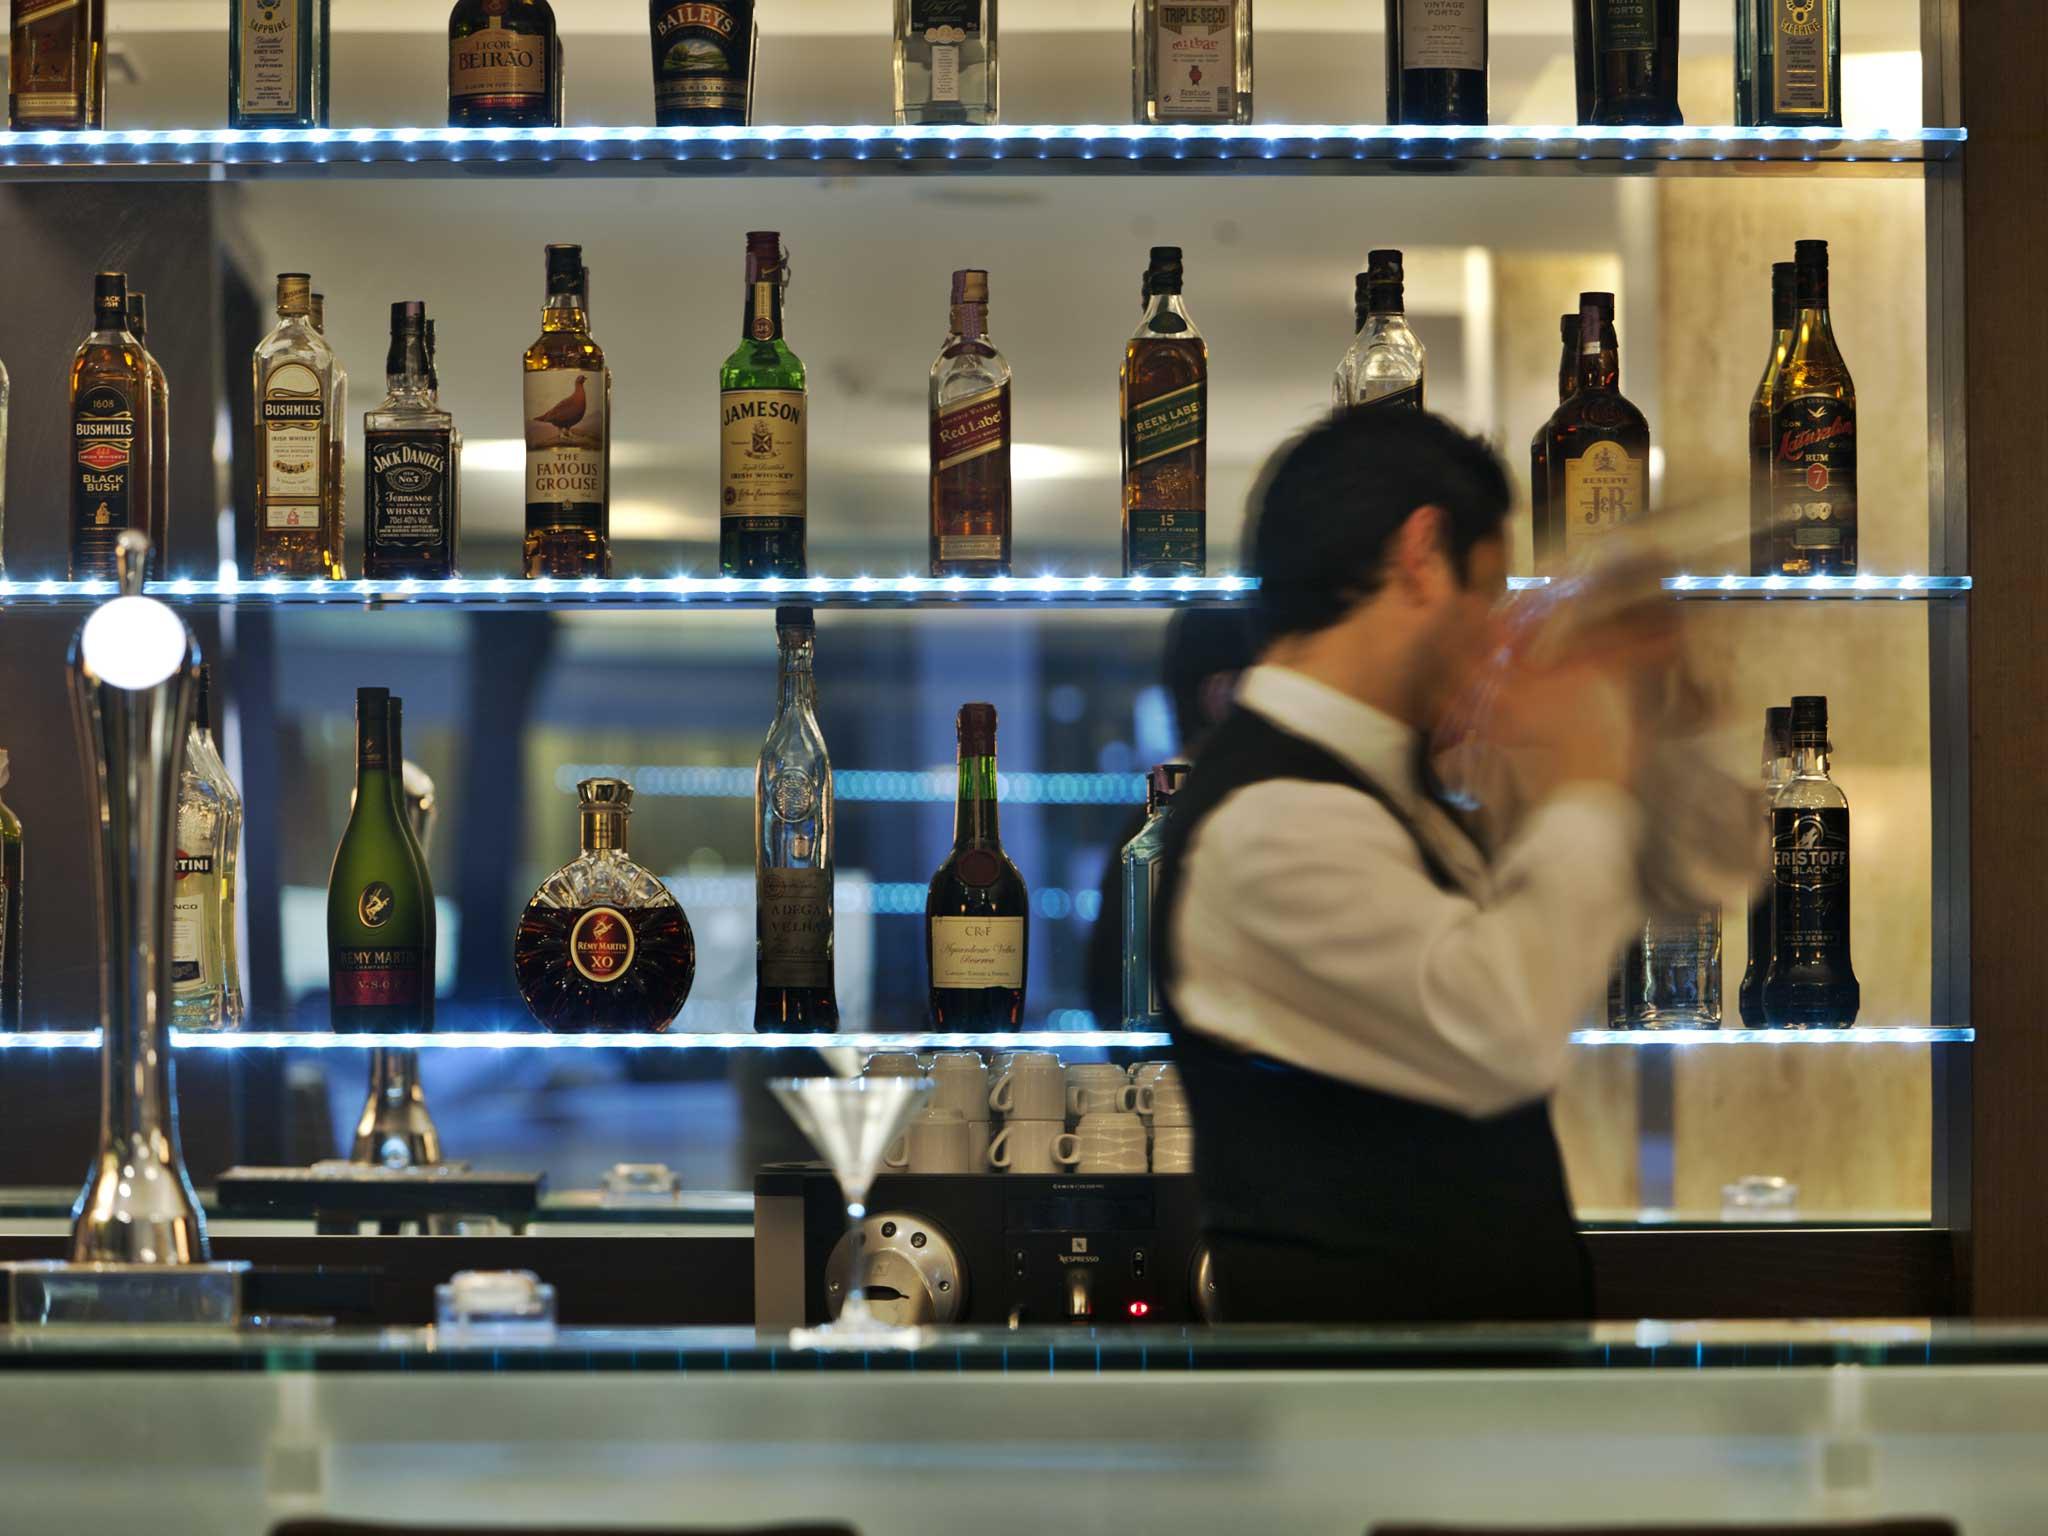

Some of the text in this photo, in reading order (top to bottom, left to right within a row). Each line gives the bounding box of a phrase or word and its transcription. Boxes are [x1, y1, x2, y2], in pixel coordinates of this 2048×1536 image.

[1424, 1, 1465, 9] VINTAGE
[1427, 9, 1462, 17] PORTO
[657, 6, 734, 36] BAILEYS
[475, 40, 511, 50] LICOR
[459, 48, 533, 70] BEIRÃO
[92, 399, 115, 409] 1608
[265, 403, 321, 416] BUSHMILLS
[723, 401, 801, 426] JAMESON
[76, 423, 132, 436] BUSHMILLS
[940, 423, 967, 443] Red
[373, 451, 402, 473] JACK
[557, 453, 579, 461] THE
[1805, 453, 1829, 462] RUM
[536, 462, 598, 476] FAMOUS
[82, 474, 124, 483] BLACK
[535, 477, 599, 491] GROUSE
[1813, 470, 1823, 485] 7
[86, 483, 120, 492] BUSH
[386, 507, 433, 515] WHISKEY
[1160, 514, 1176, 527] 15
[1774, 851, 1847, 865] ERISTOFF
[174, 859, 210, 871] TINI
[1791, 865, 1829, 875] BLACK
[599, 942, 627, 951] MARTIN
[591, 955, 614, 969] XO
